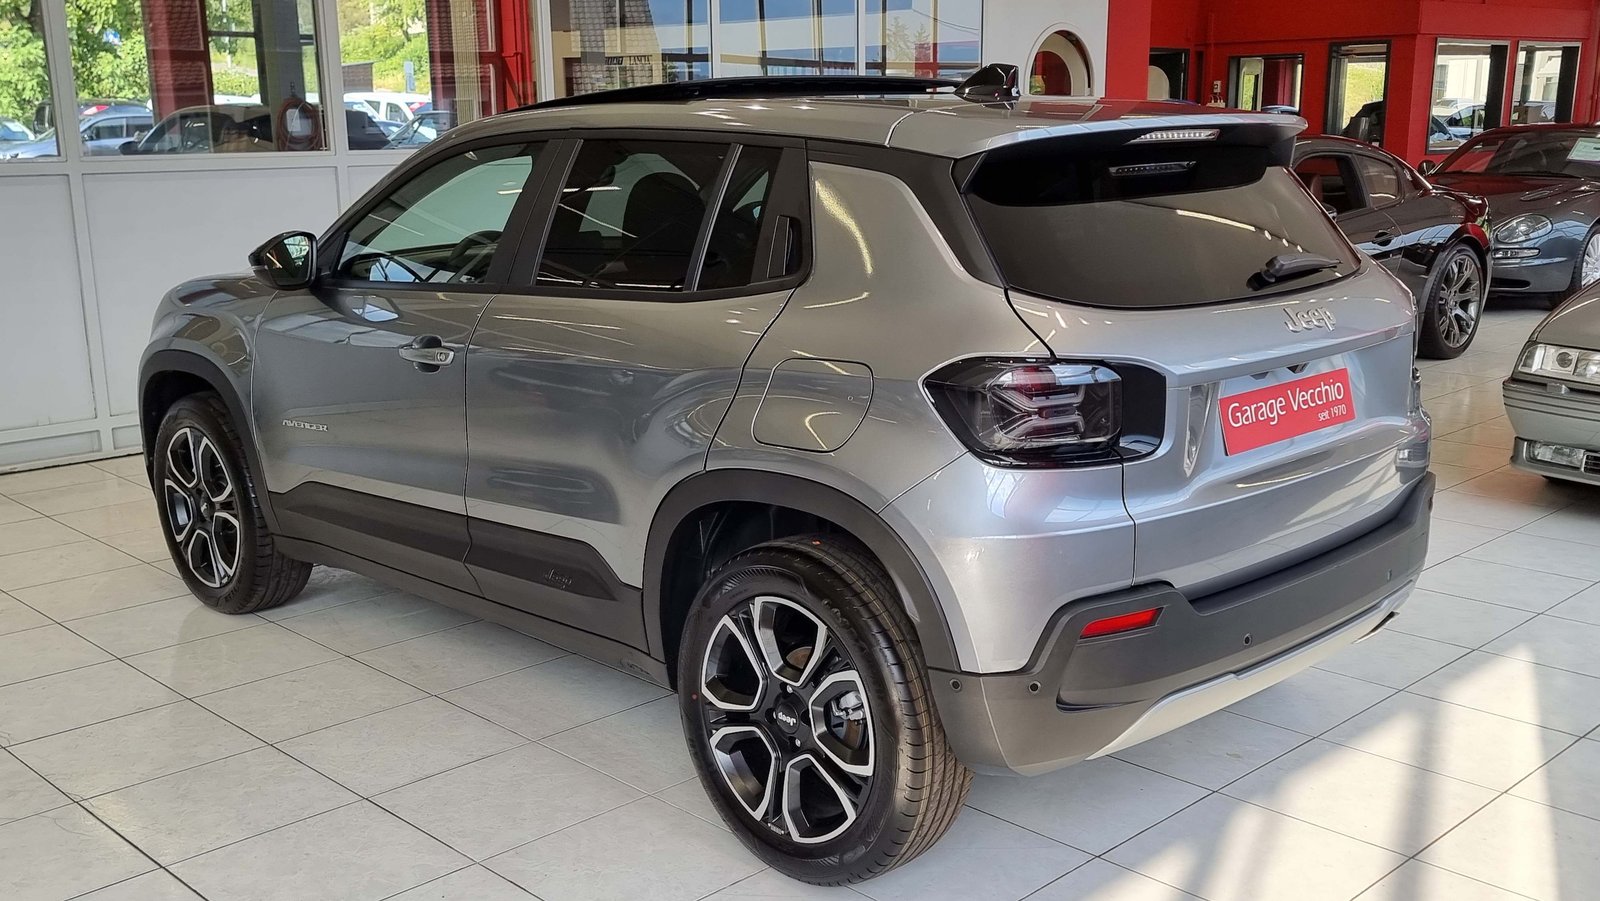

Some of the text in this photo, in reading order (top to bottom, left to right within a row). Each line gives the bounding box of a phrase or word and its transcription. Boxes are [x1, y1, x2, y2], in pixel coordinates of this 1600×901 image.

[1283, 306, 1336, 333] Jeep
[1228, 379, 1344, 428] Garage Vecchio
[1317, 404, 1347, 422] seit 1970
[282, 419, 328, 432] AVENGER
[777, 711, 797, 727] Jeep
